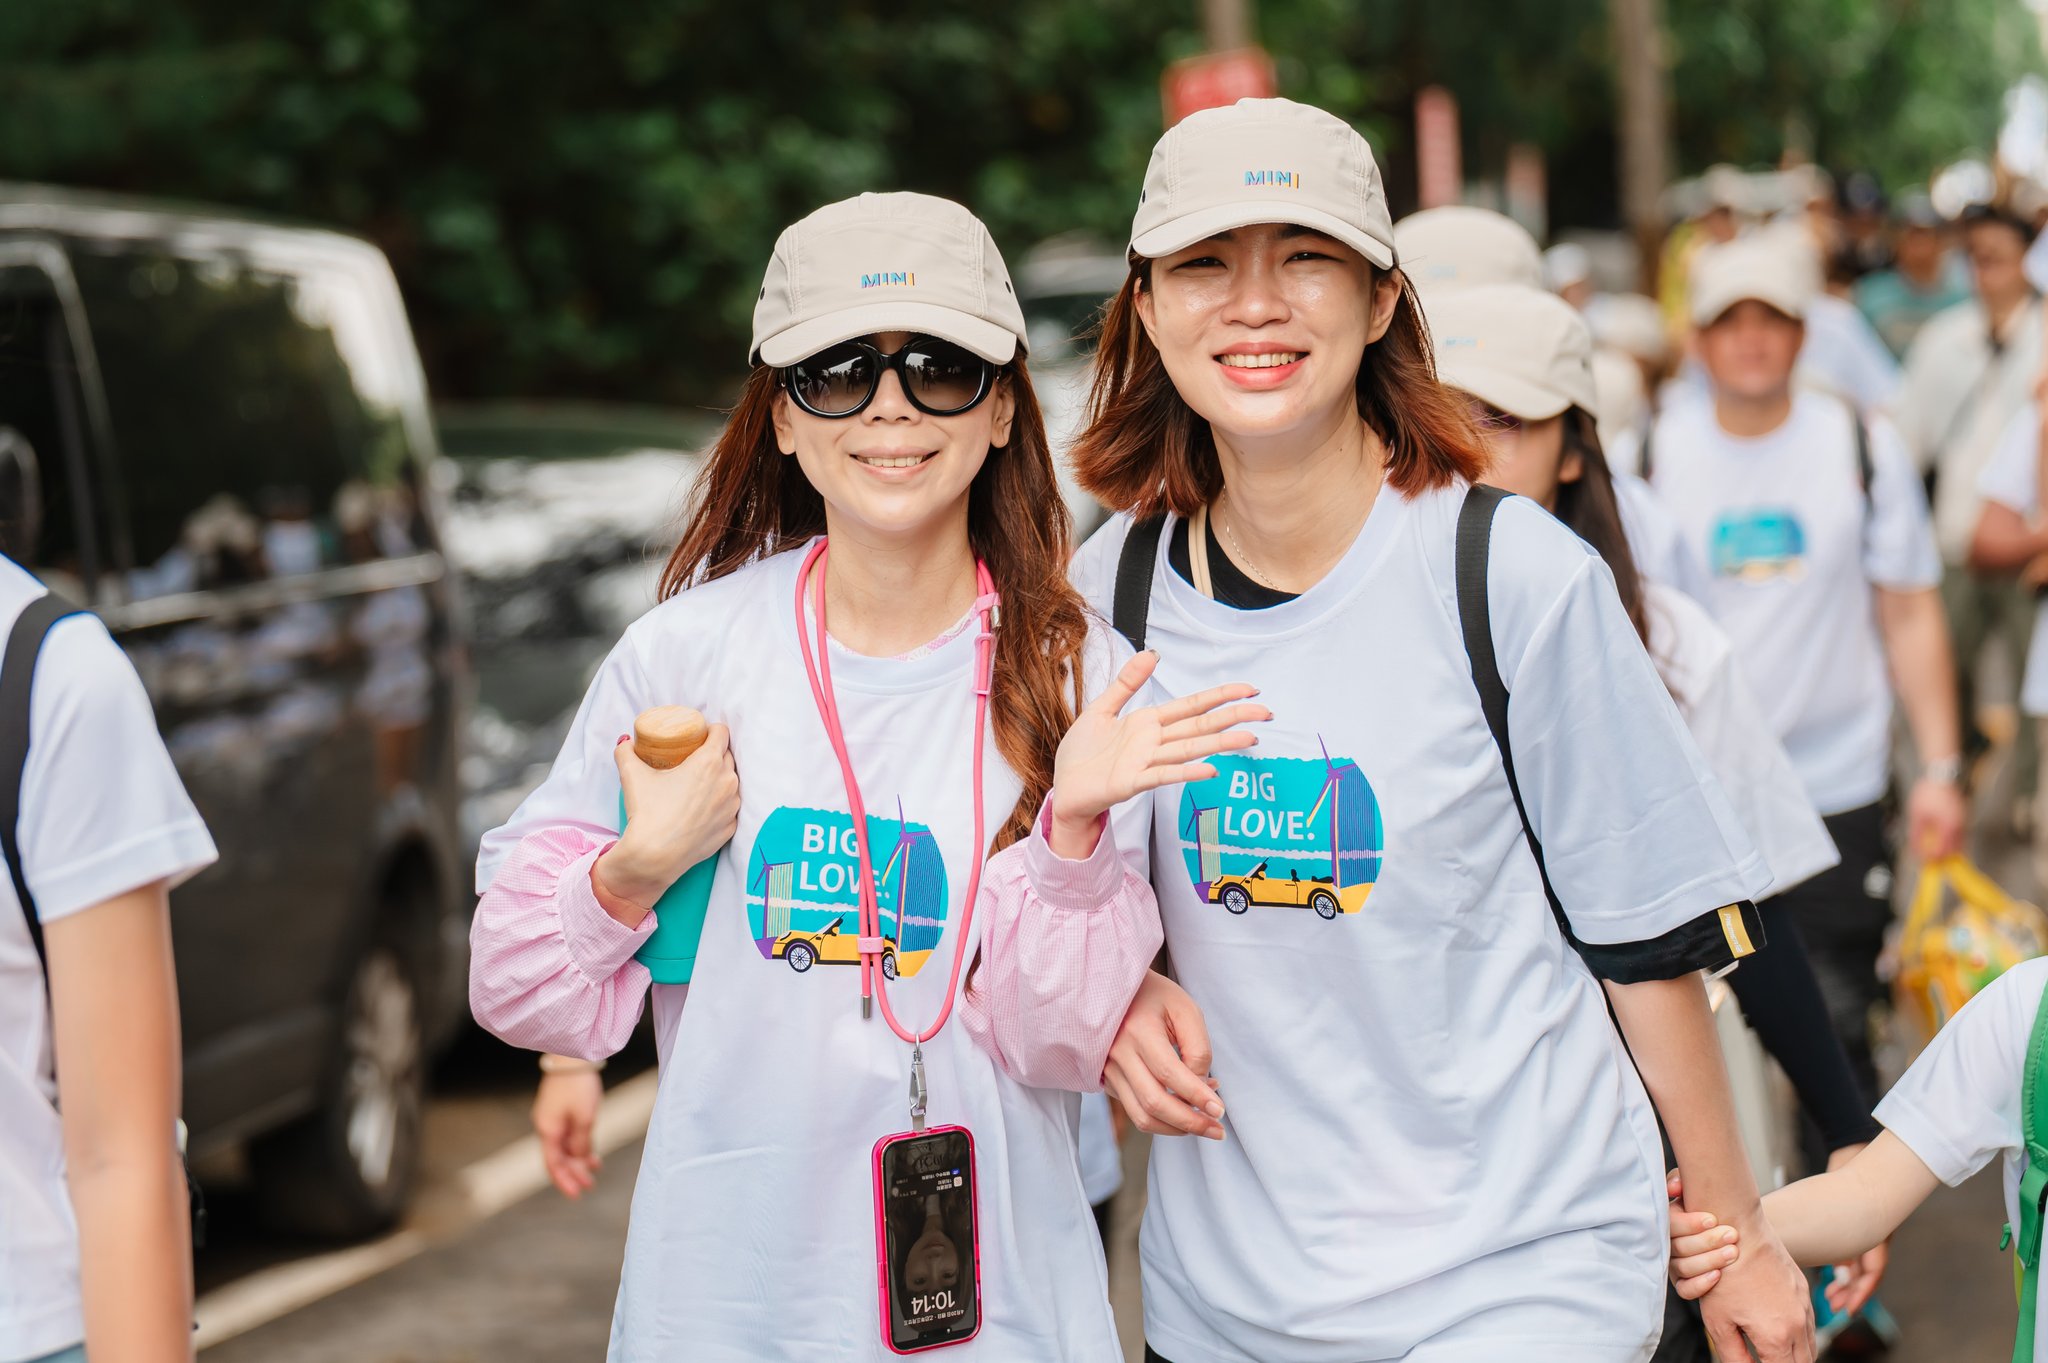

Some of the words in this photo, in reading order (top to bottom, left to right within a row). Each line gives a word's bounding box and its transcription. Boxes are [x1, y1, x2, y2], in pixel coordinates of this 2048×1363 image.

[1244, 170, 1300, 190] MINI
[861, 272, 915, 289] MINI
[1228, 770, 1276, 802] BIG
[1224, 806, 1316, 841] LOVE.
[802, 823, 861, 859] BIG
[799, 861, 890, 899] LOV.
[911, 1290, 956, 1315] 10:14
